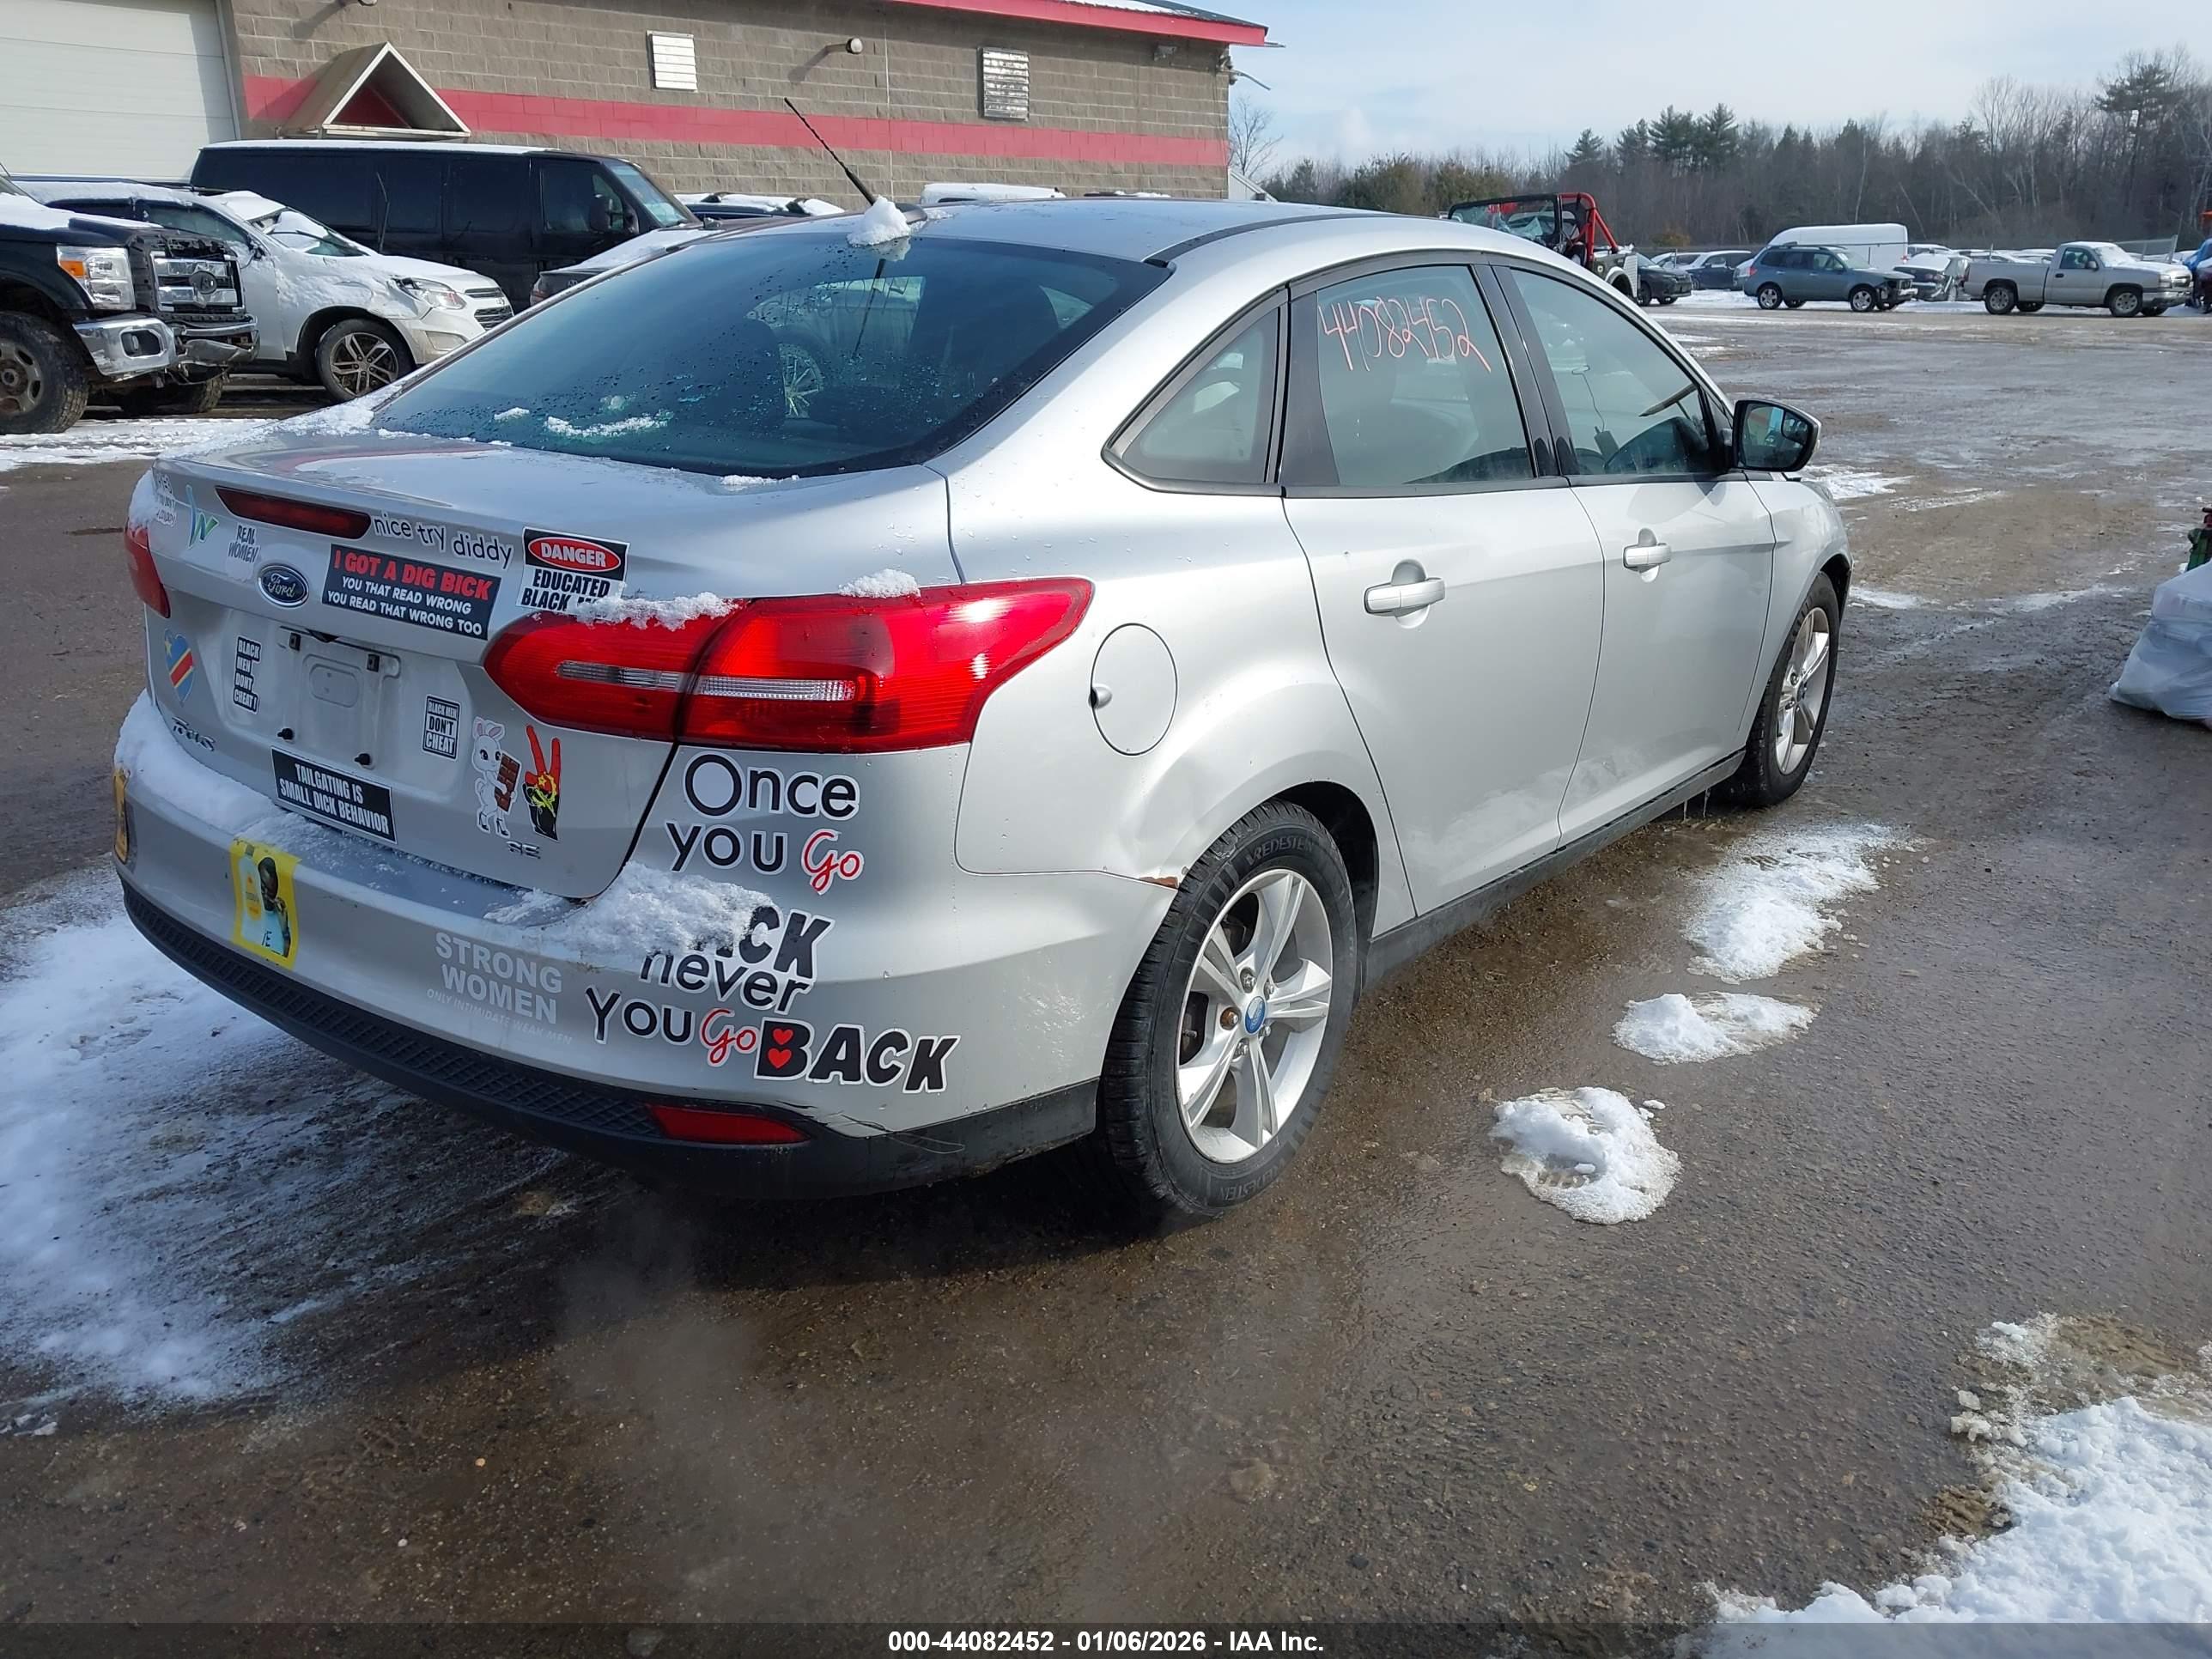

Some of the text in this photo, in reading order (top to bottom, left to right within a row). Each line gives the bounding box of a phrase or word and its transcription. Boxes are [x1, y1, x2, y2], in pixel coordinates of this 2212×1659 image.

[1318, 296, 1492, 373] 44082452
[228, 542, 258, 563] WOMEN
[236, 525, 256, 545] REAL
[374, 513, 512, 569] nice try diddy
[540, 542, 606, 568] DANGER
[267, 573, 296, 599] Ford
[333, 550, 493, 600] I GOT A DIG BICK
[342, 576, 471, 615] YOU THAT READ WRONG
[532, 568, 611, 599] EDUCATED
[327, 590, 483, 635] YOU READ THAT WRONG TOO
[520, 587, 572, 612] BLACK
[236, 656, 252, 673] MEN
[238, 640, 260, 659] BLACK
[428, 702, 457, 720] BLACK MEN
[428, 715, 454, 736] DON'T
[426, 732, 454, 754] CHEAT
[295, 763, 364, 805] TAILGATING IS
[684, 754, 856, 817] Once
[279, 778, 389, 835] SMALL DICK BEHAVIOR
[804, 831, 860, 892] Go
[434, 932, 562, 994] STRONG
[640, 949, 810, 1012] never
[426, 988, 452, 1004] ONLY
[453, 998, 510, 1028] INTIMIDATE
[514, 1019, 544, 1036] WEAK
[441, 963, 556, 1024] WOMEN
[701, 1009, 757, 1065] Go
[757, 1019, 958, 1092] BACK
